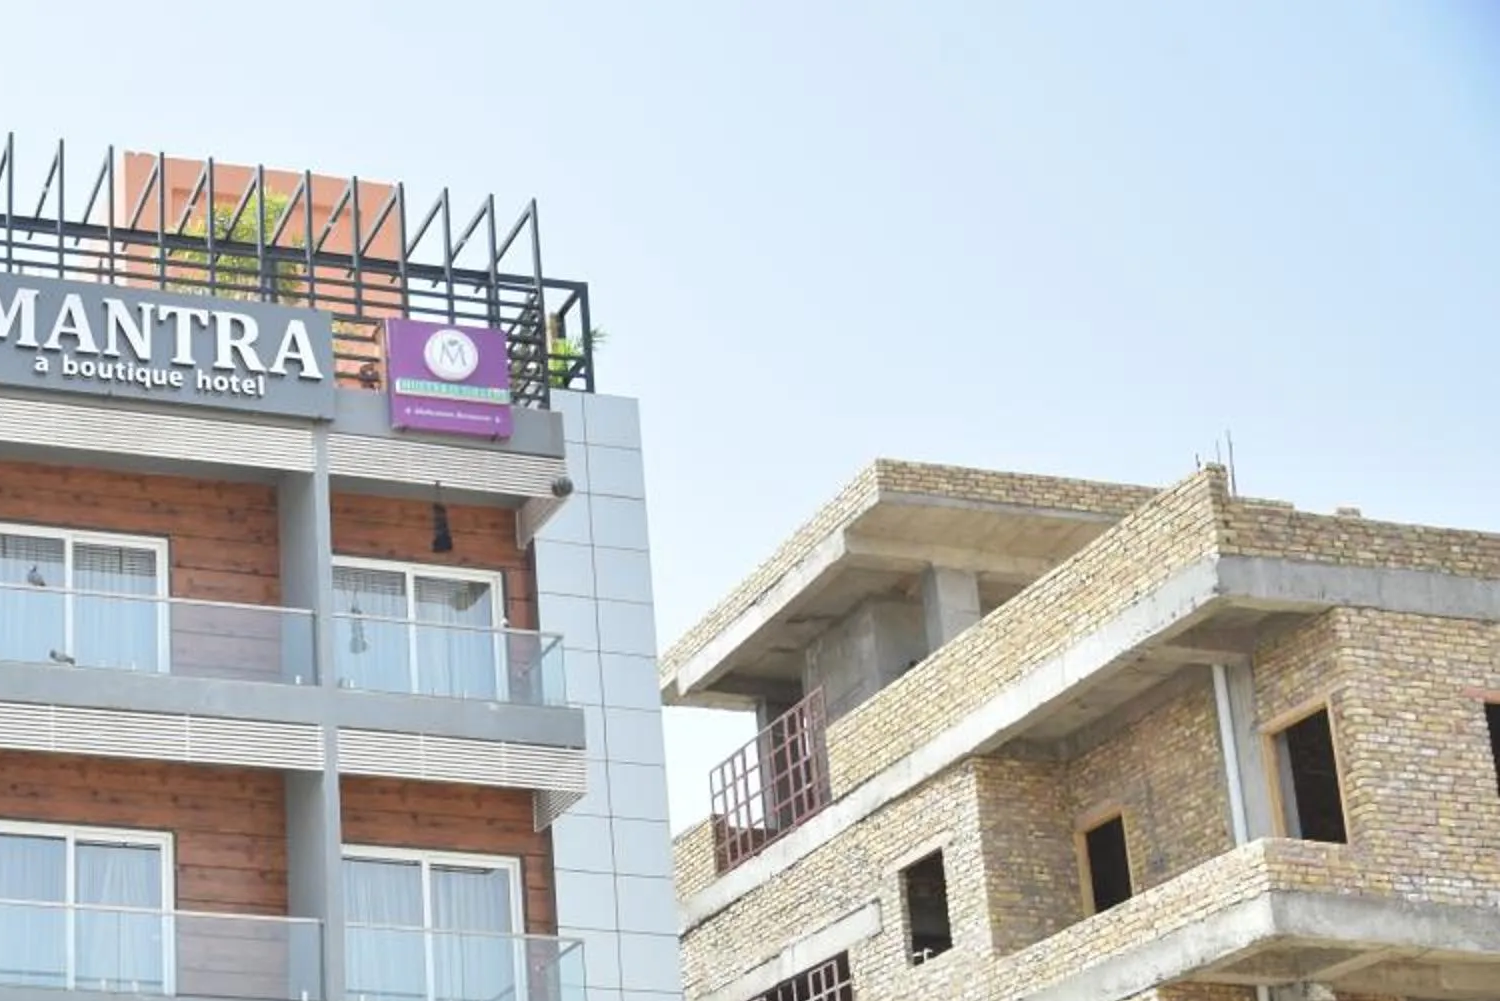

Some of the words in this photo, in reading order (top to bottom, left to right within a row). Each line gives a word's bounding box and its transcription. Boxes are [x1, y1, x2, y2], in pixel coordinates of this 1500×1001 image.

[34, 355, 49, 372] a
[62, 353, 184, 388] boutique
[196, 368, 266, 396] hotel
